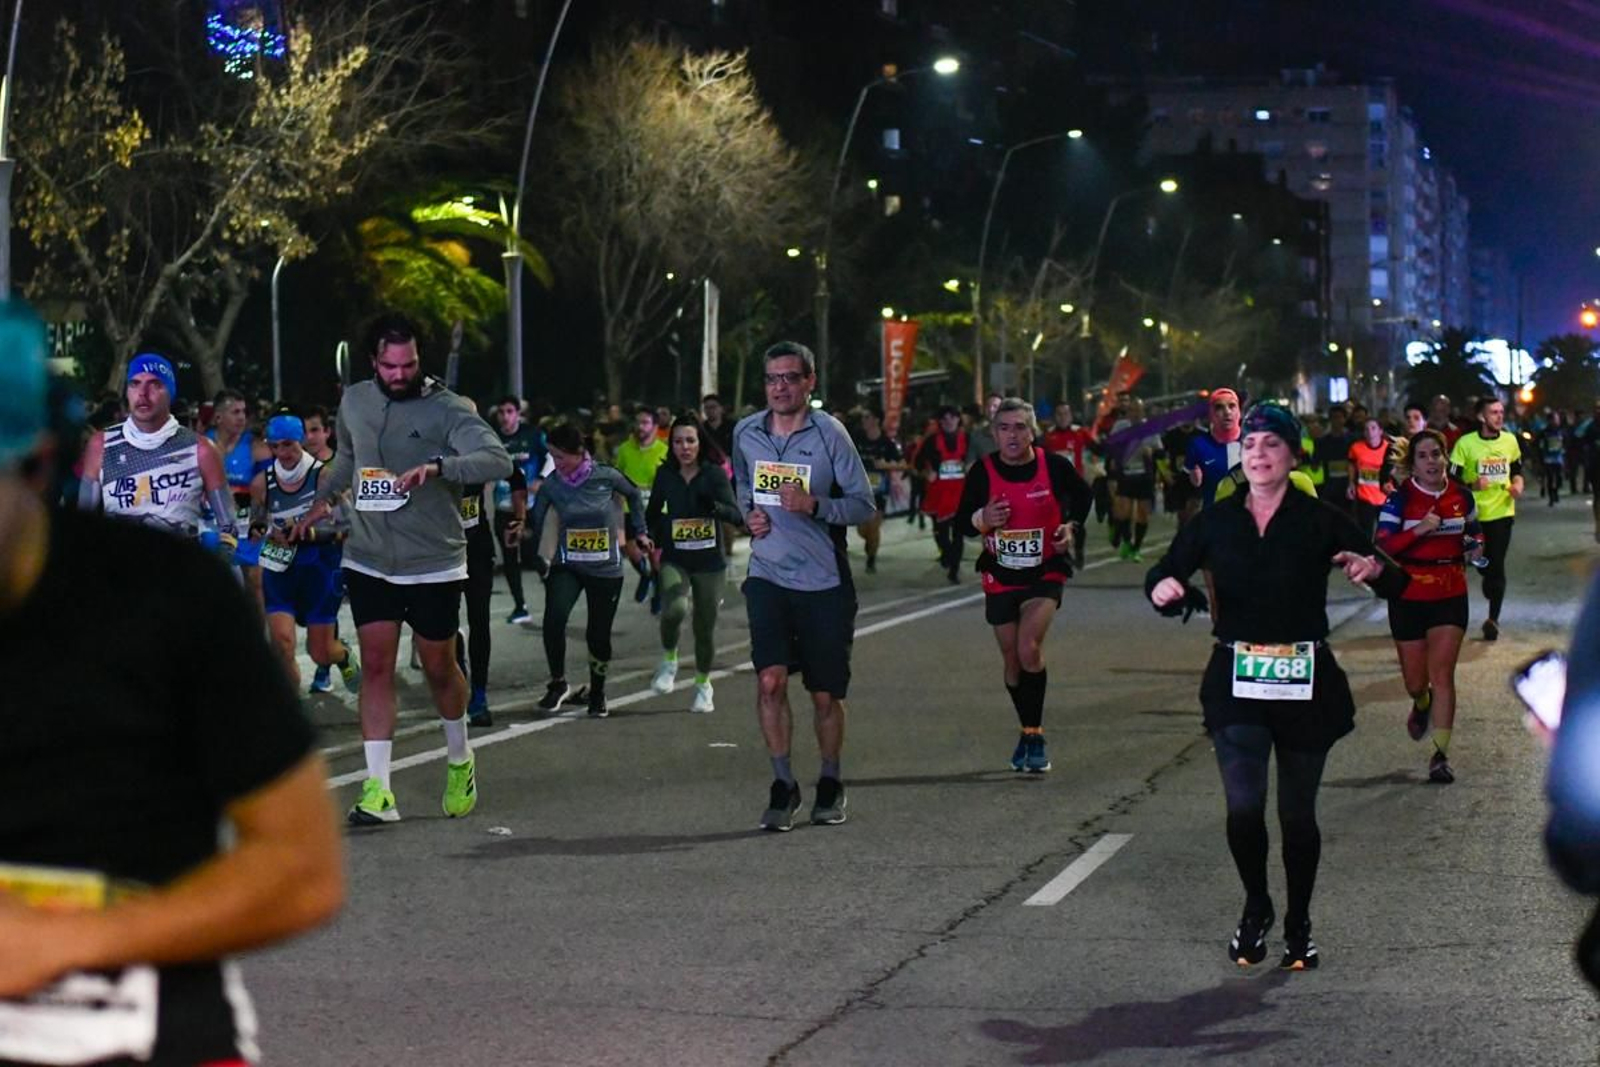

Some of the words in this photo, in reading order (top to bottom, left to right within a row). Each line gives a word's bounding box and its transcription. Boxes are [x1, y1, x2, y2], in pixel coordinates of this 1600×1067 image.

[361, 480, 403, 495] 859
[675, 525, 713, 538] 4265
[569, 538, 605, 550] 4275
[999, 539, 1039, 553] 9613
[1241, 655, 1307, 679] 1768
